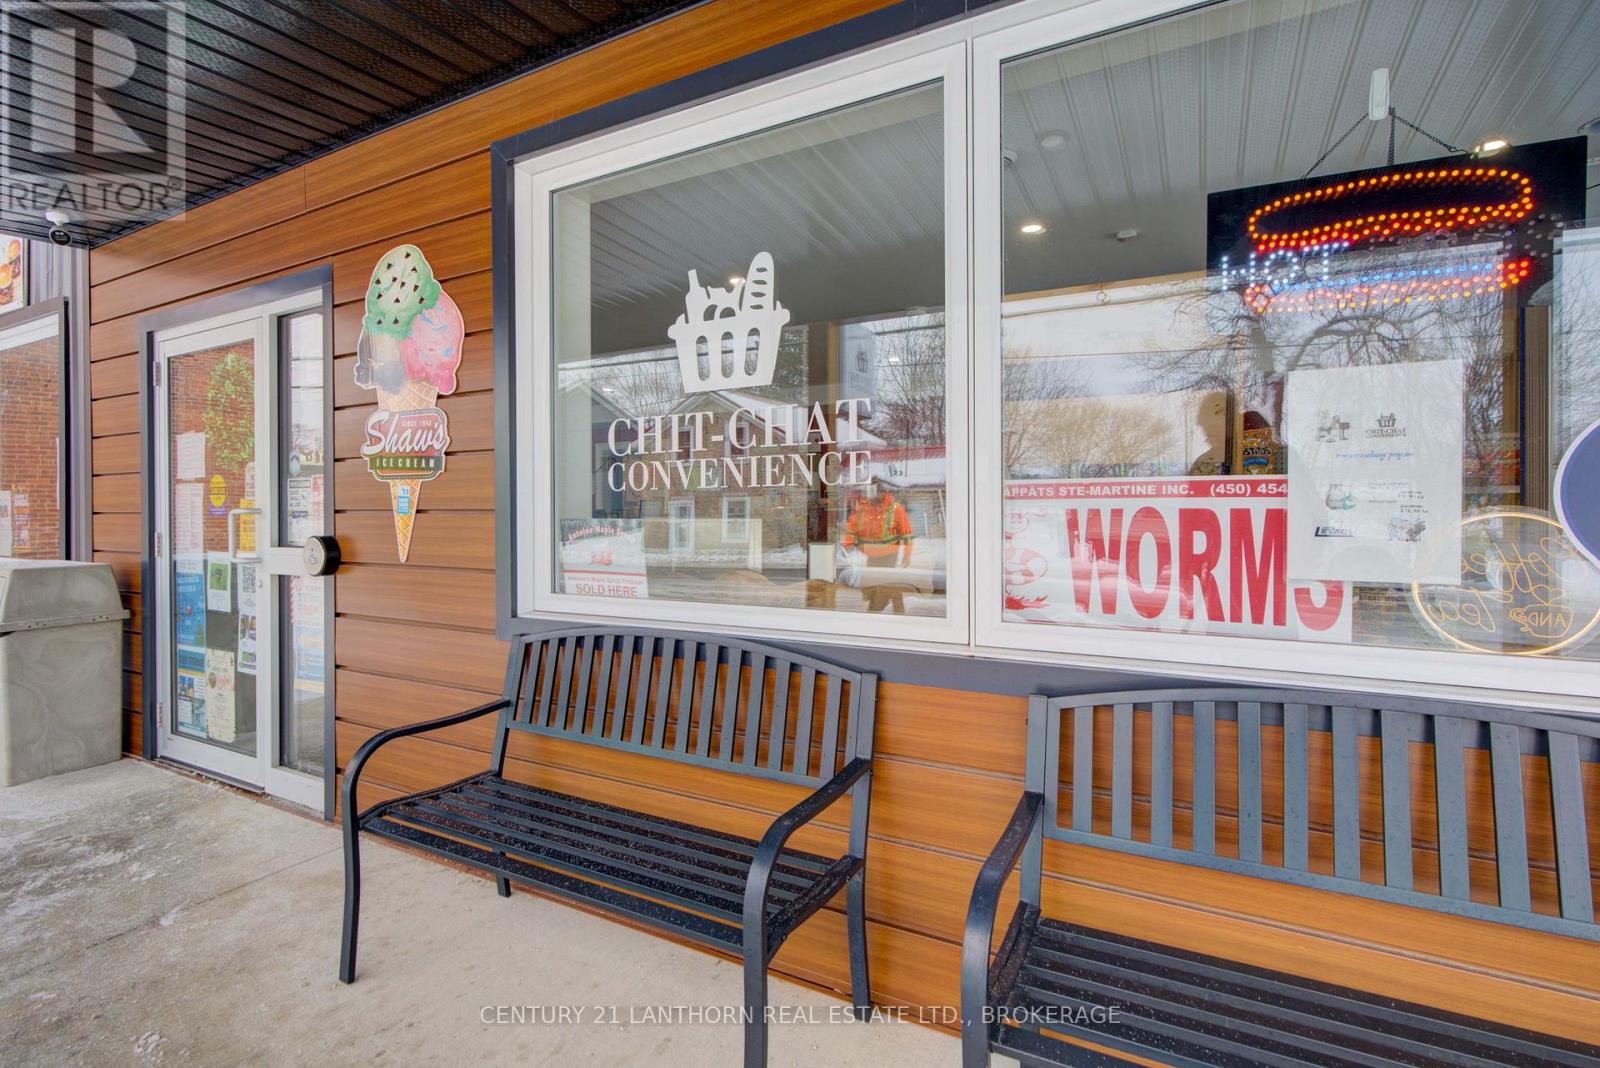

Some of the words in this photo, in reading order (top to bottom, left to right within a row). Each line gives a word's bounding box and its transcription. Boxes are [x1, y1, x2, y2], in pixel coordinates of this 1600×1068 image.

[1221, 241, 1350, 291] HOT
[362, 411, 446, 455] Shaw's
[607, 398, 872, 457] CHIT-CHAT
[607, 450, 872, 492] CONVENIENCE
[1059, 484, 1155, 496] STE-MARTINE
[1161, 483, 1194, 496] INC.
[1210, 482, 1251, 497] (450)
[1256, 482, 1288, 494] 454
[575, 583, 605, 595] SOLD
[608, 584, 637, 598] HERE
